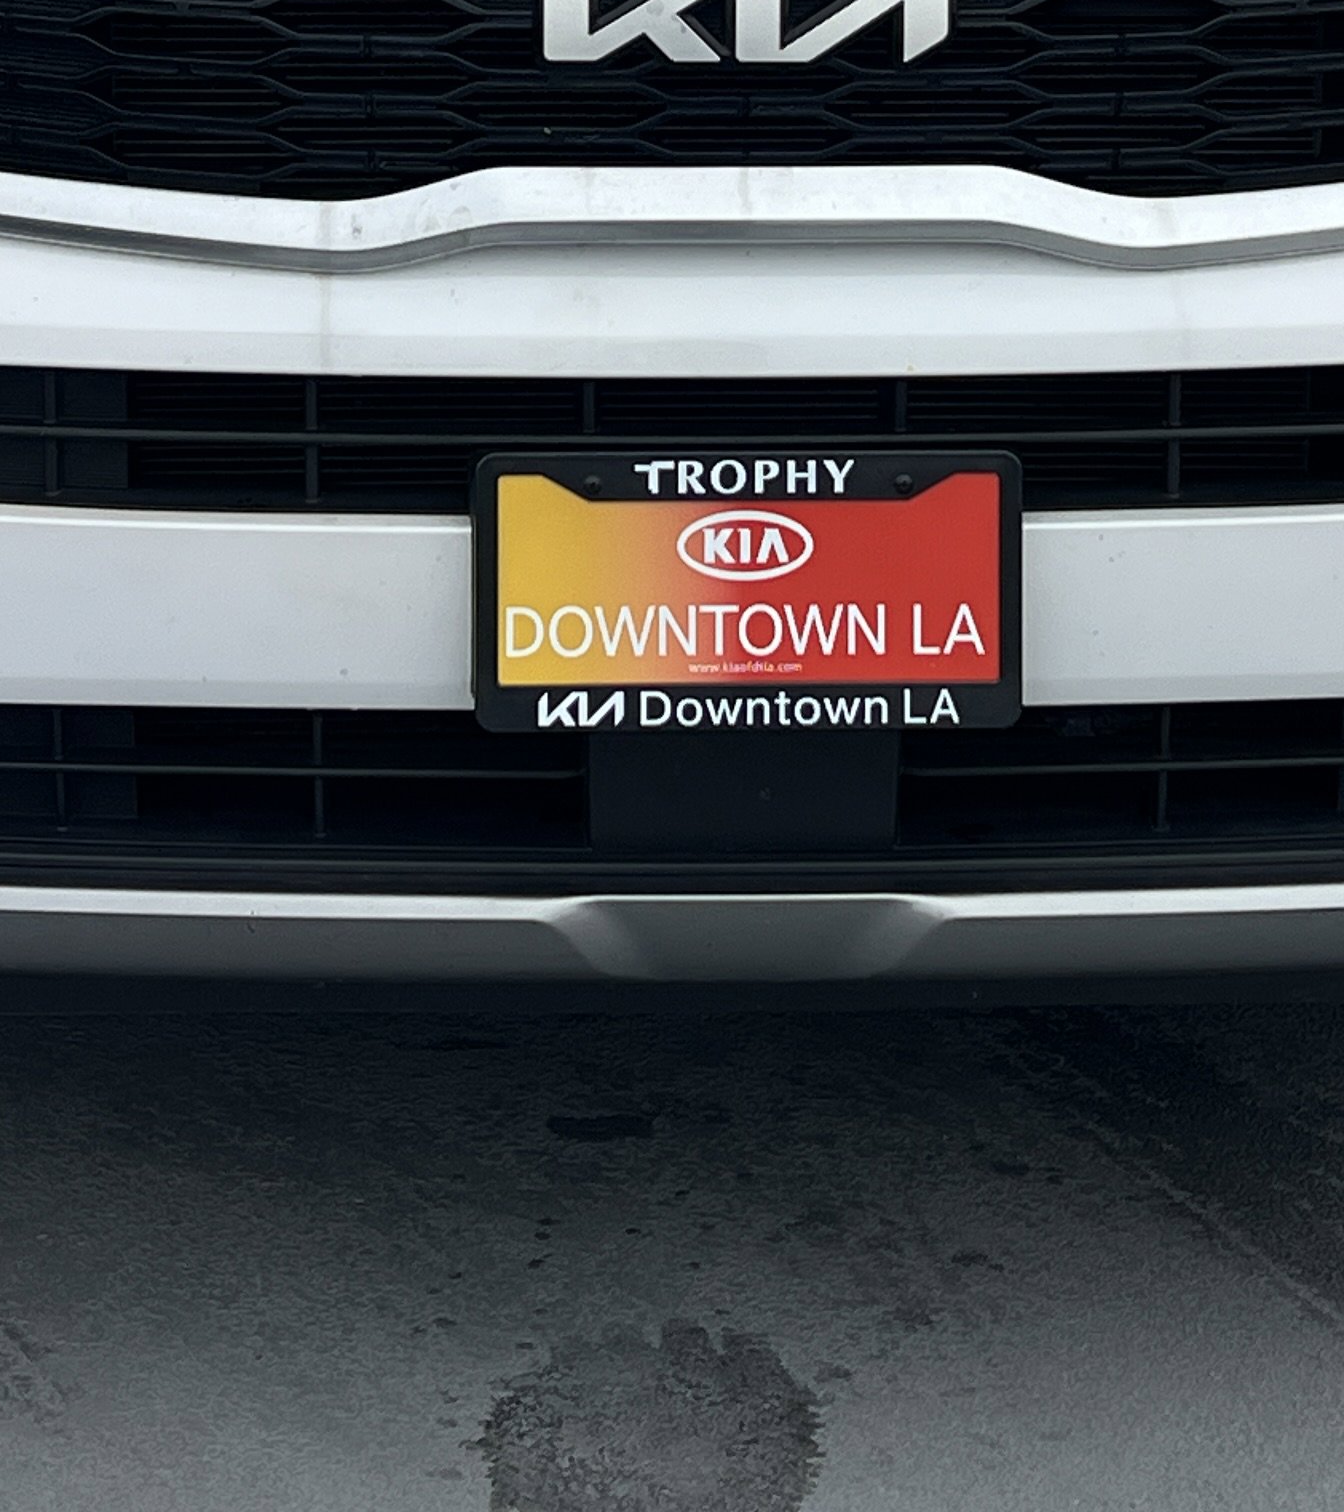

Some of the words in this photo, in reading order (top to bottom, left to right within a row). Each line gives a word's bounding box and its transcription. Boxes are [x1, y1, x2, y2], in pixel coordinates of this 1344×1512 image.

[634, 459, 855, 495] TROPHY
[702, 527, 790, 565] KIA
[504, 603, 887, 659] DOWNTOWN
[911, 603, 987, 656] LA
[537, 690, 625, 727] KIA
[639, 689, 889, 727] Downtown
[902, 688, 960, 725] LA
